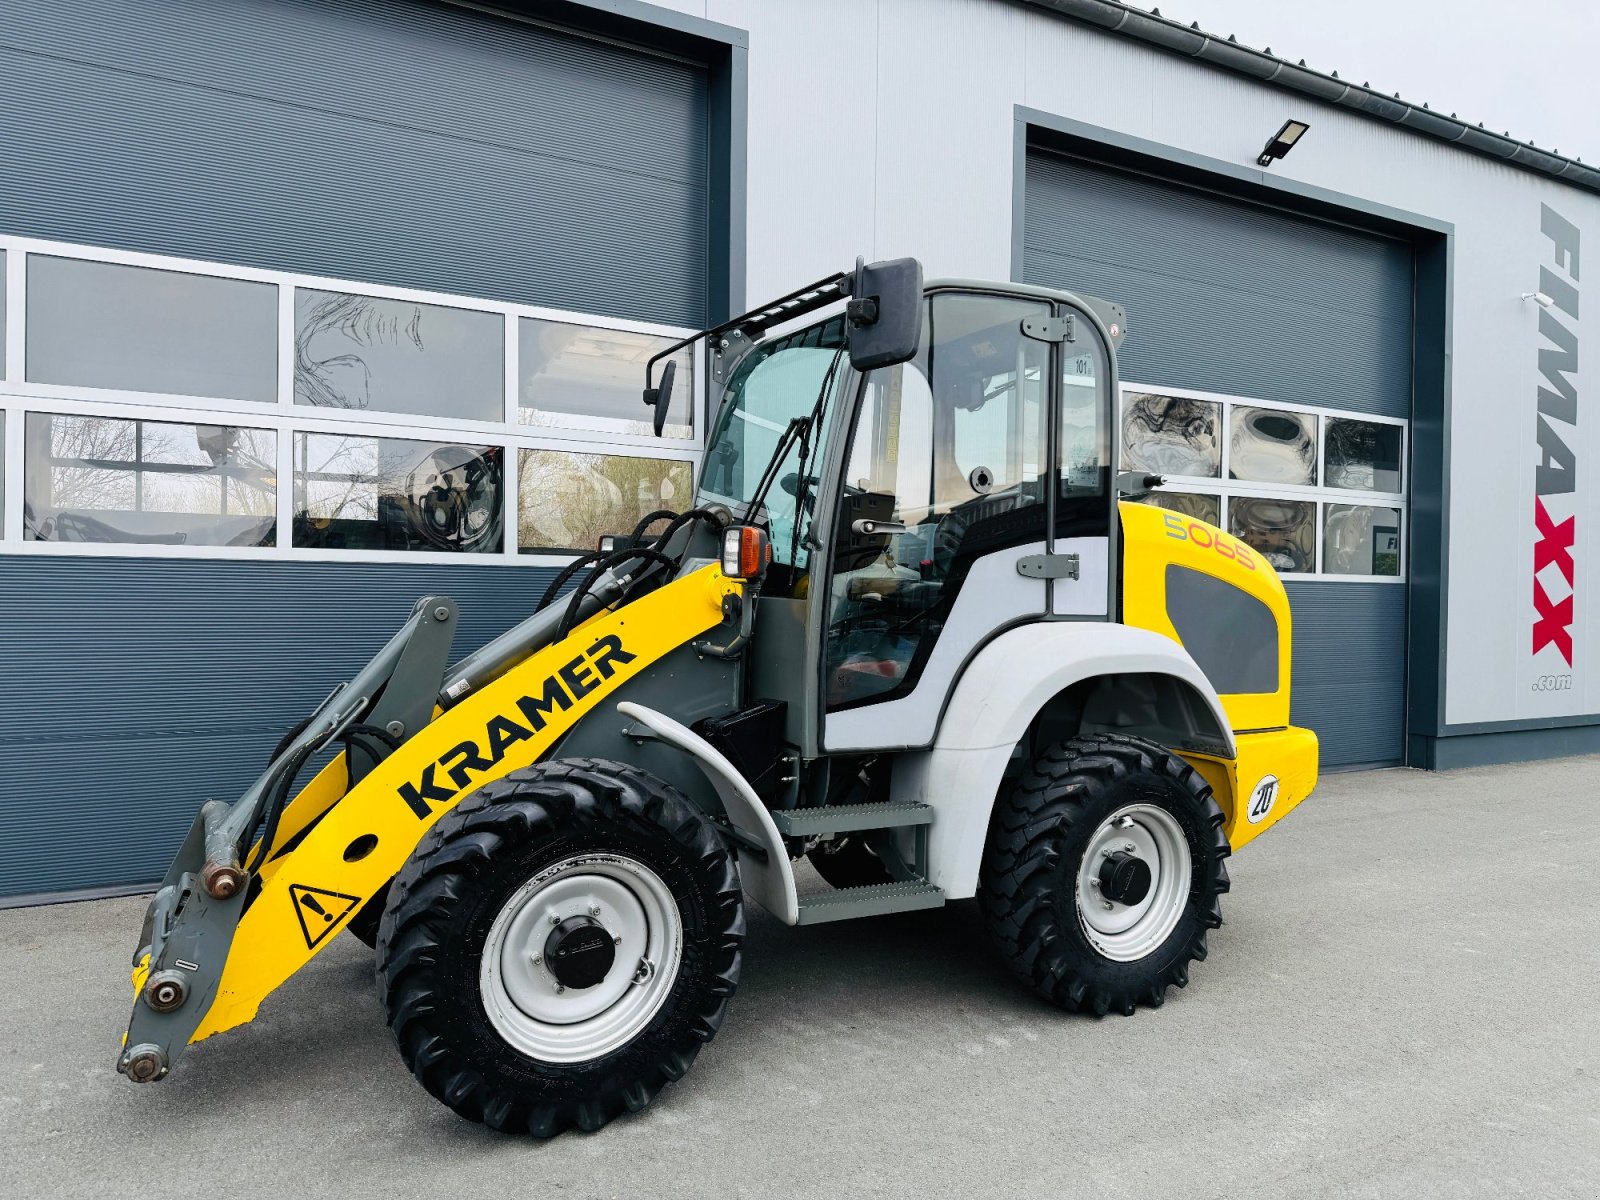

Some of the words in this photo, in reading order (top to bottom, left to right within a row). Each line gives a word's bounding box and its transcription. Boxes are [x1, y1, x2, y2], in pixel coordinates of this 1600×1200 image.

[1076, 359, 1087, 375] 101
[1532, 201, 1580, 669] FIMAXX
[1163, 514, 1256, 571] 5065
[1531, 674, 1571, 691] .com
[397, 634, 638, 821] KRAMER
[1252, 782, 1274, 816] 20
